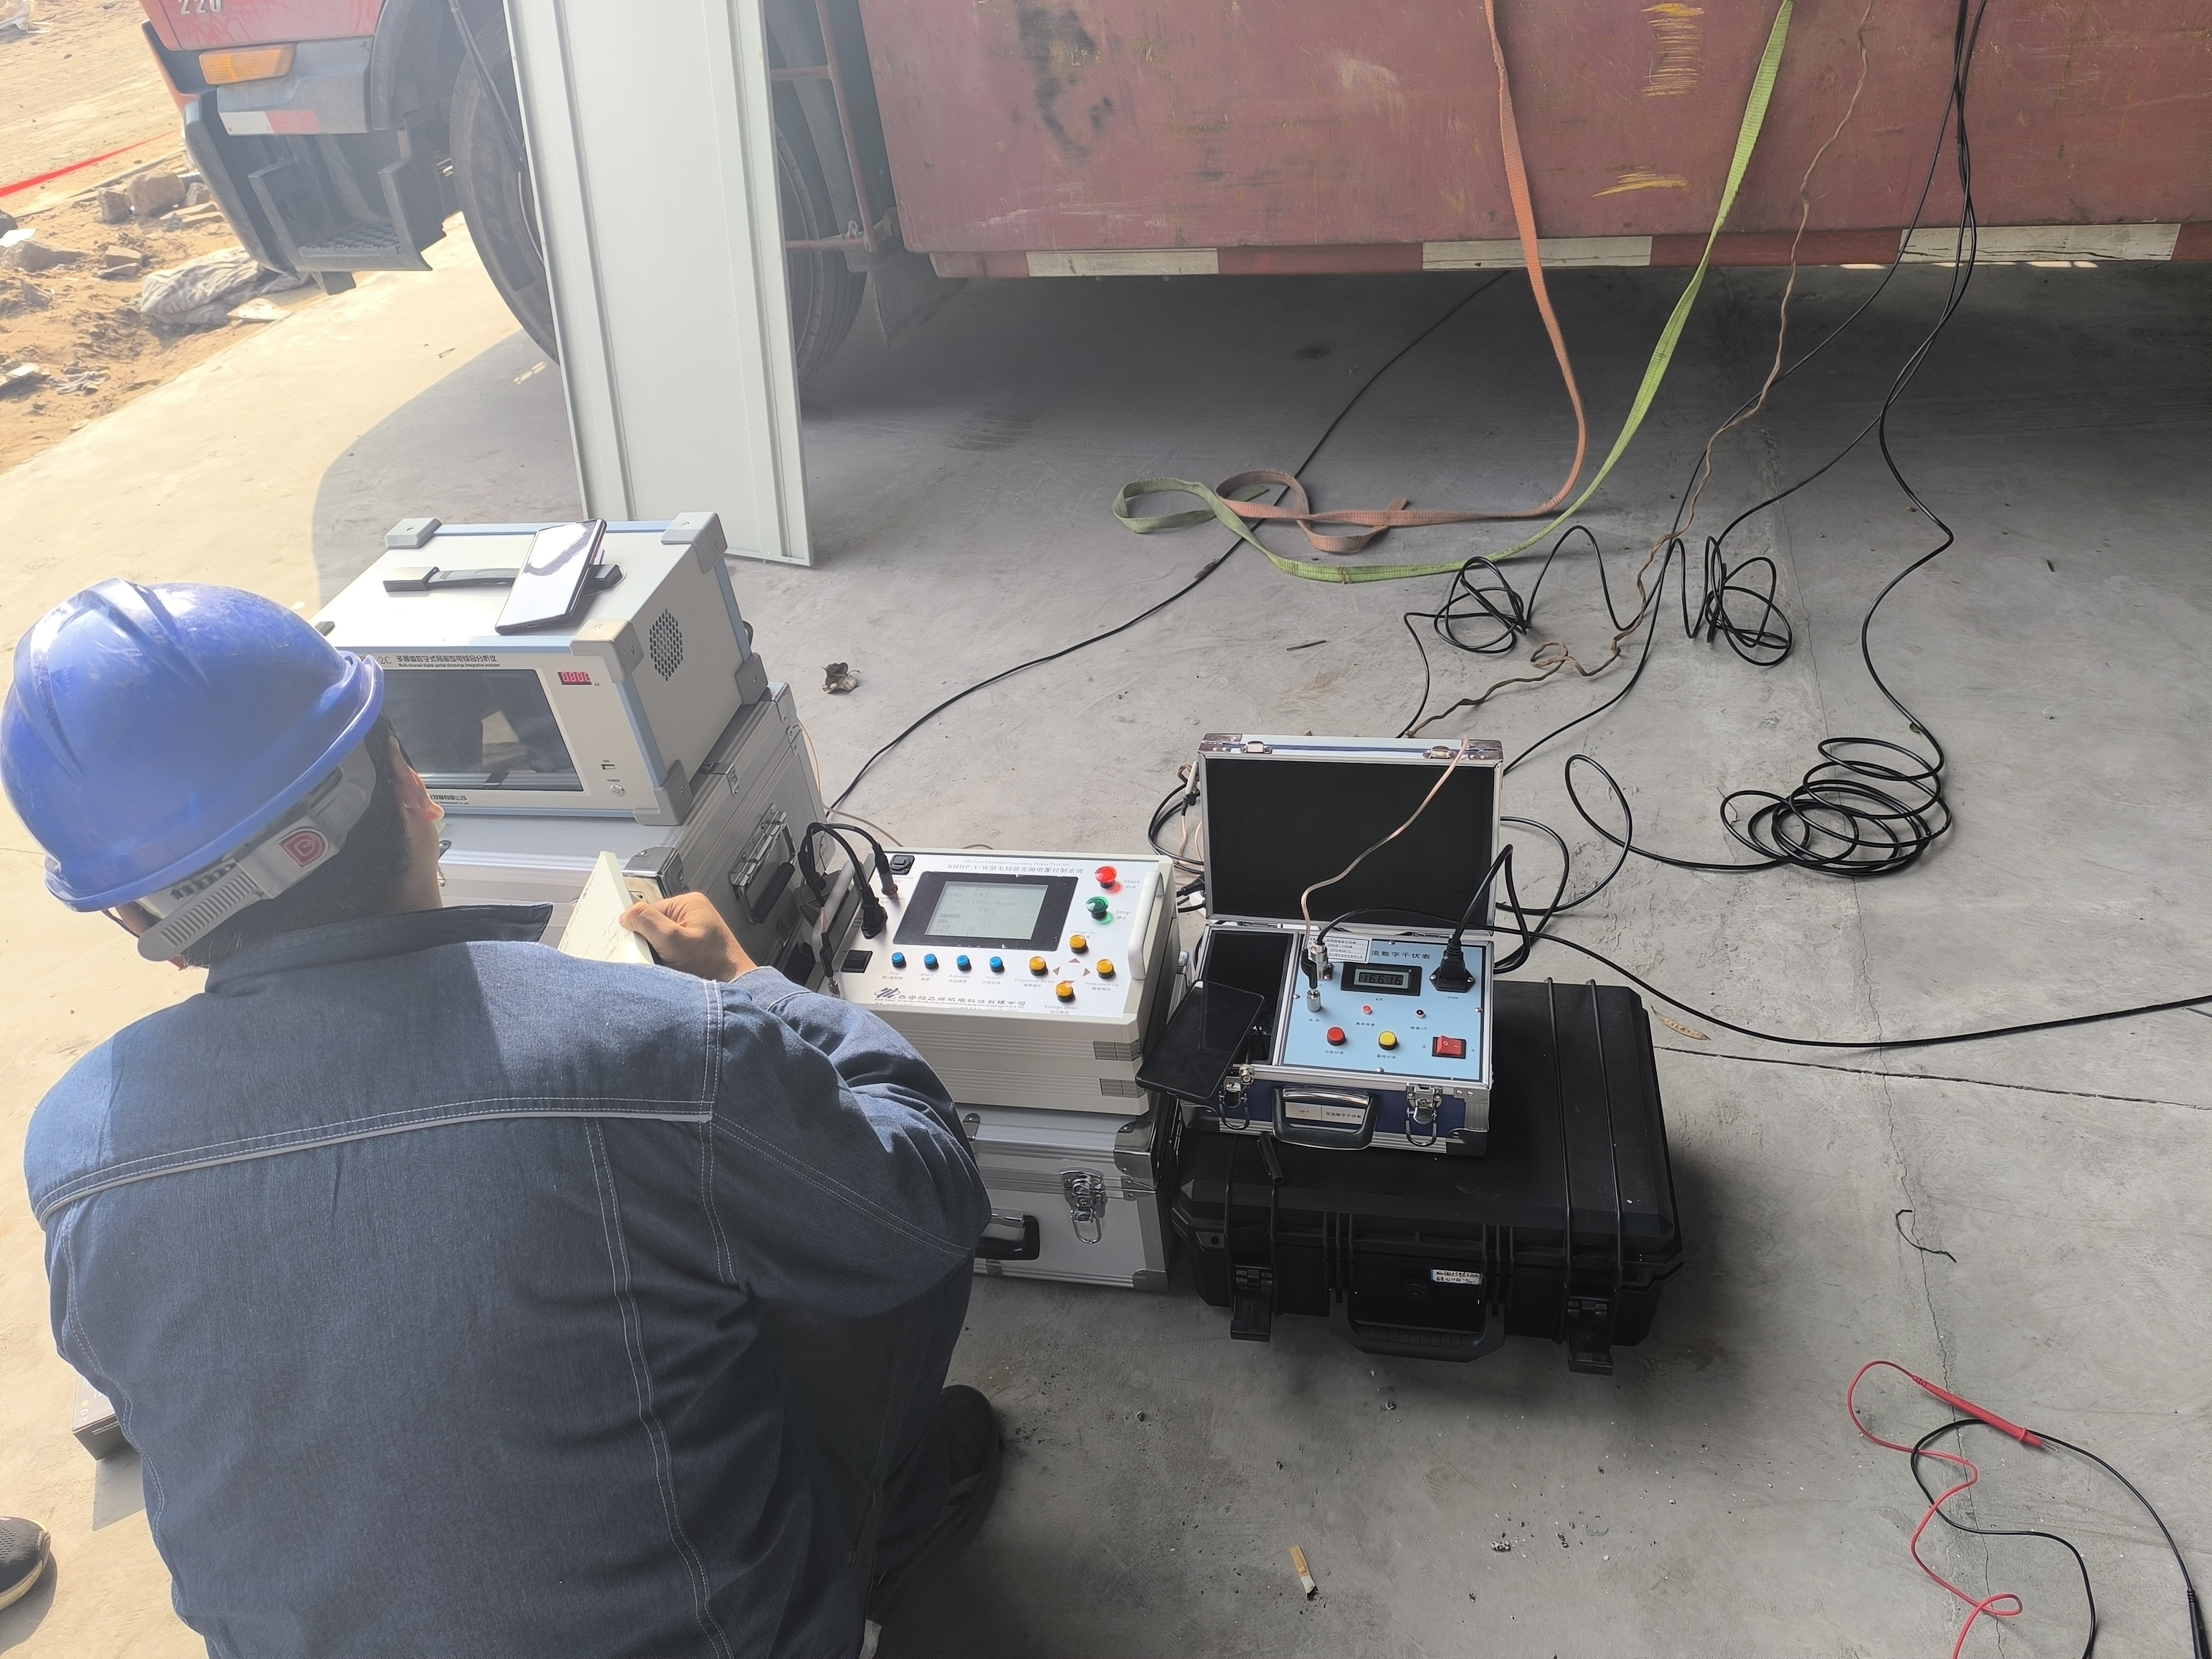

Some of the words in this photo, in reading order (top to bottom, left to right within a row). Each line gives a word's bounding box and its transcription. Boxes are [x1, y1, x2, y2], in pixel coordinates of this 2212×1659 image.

[1371, 950, 1430, 960] 流数字千伏表
[898, 995, 1026, 1006] 西安旭之辉机电科技有限公司
